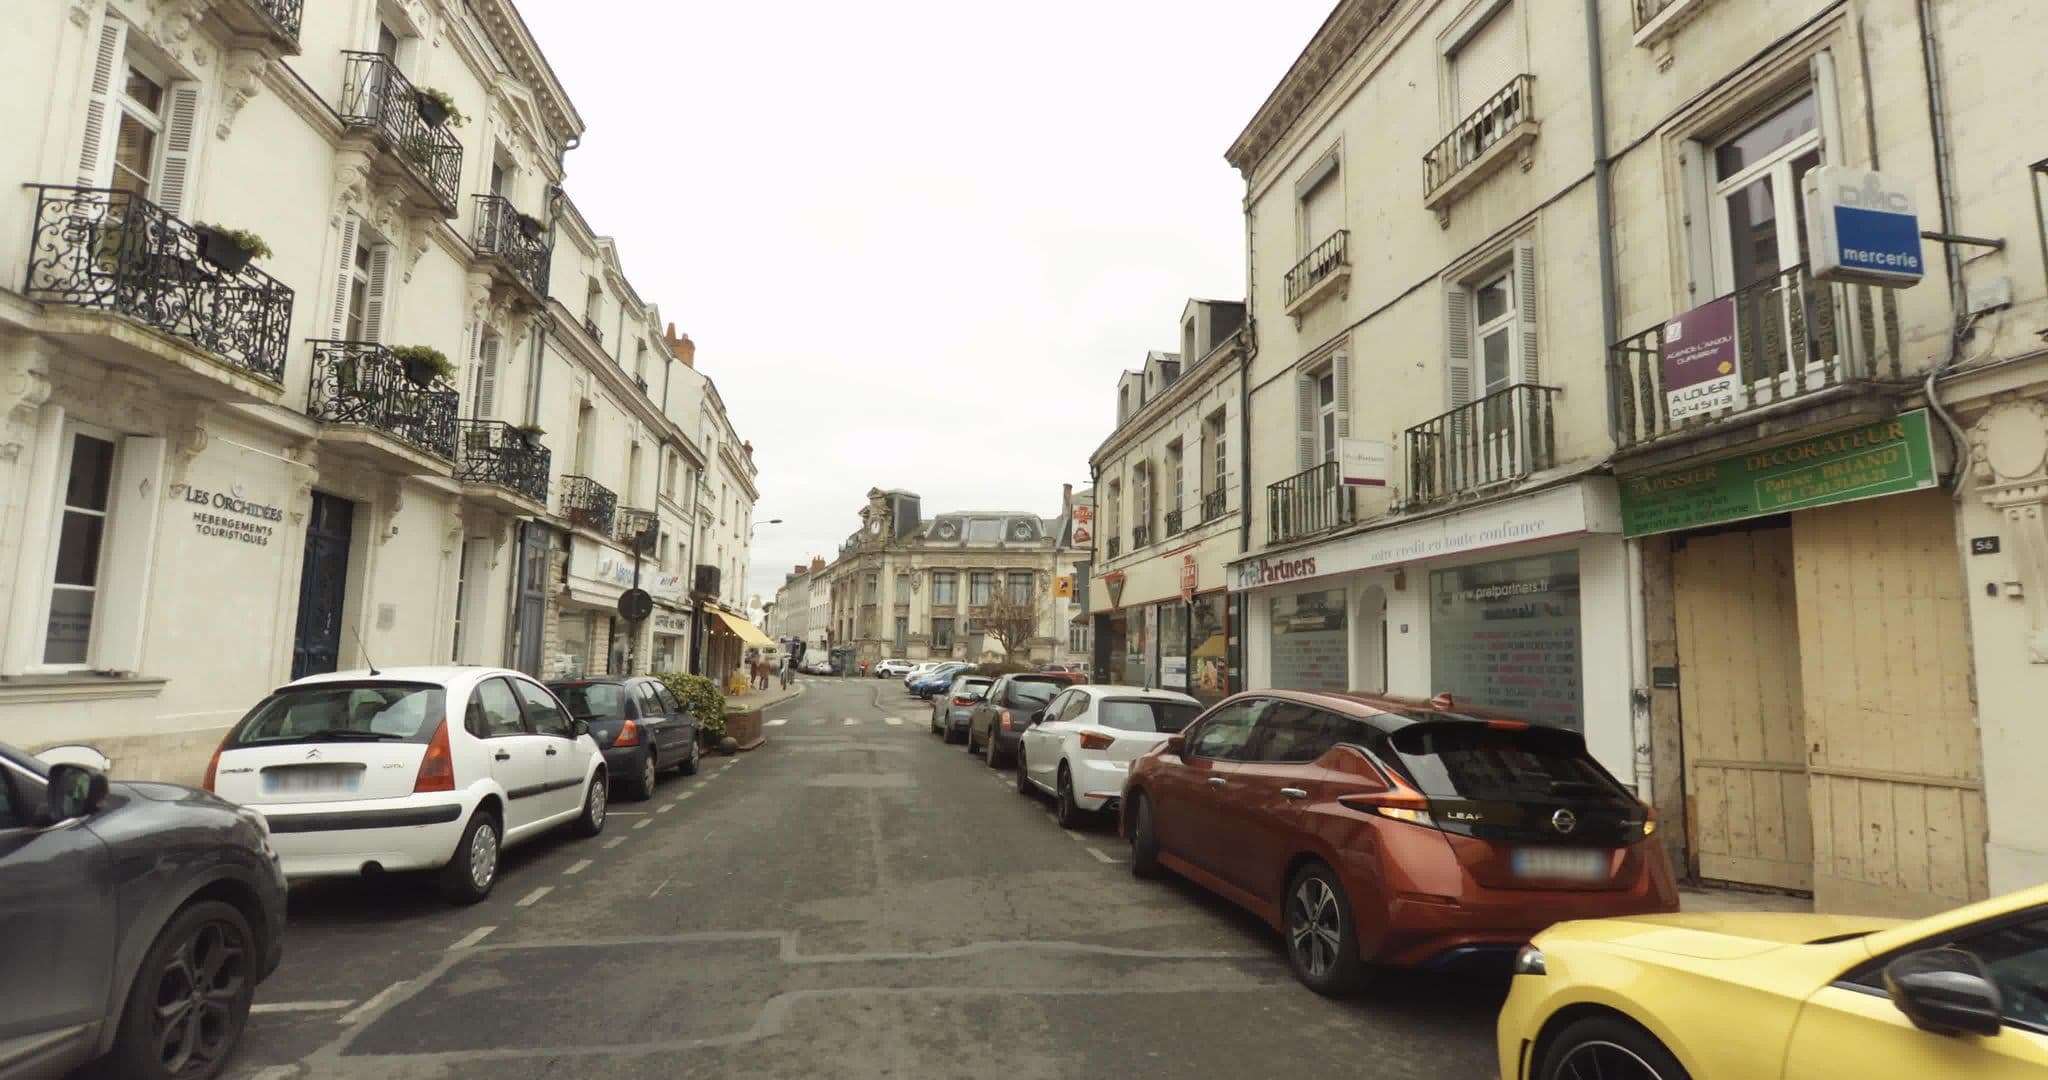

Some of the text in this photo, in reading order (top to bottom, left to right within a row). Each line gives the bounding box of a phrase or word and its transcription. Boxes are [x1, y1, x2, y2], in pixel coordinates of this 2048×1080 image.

[1843, 247, 1918, 267] mercerie
[1672, 380, 1731, 405] A LOUER
[1672, 406, 1687, 417] 02
[1631, 467, 1718, 494] TAPISSIER
[186, 485, 283, 523] LES ORCHIDÉES
[193, 511, 273, 537] HEBERGEMENTS
[196, 523, 269, 547] TOURISTIQUES
[1479, 519, 1545, 543] confiance
[1975, 540, 1993, 551] 56
